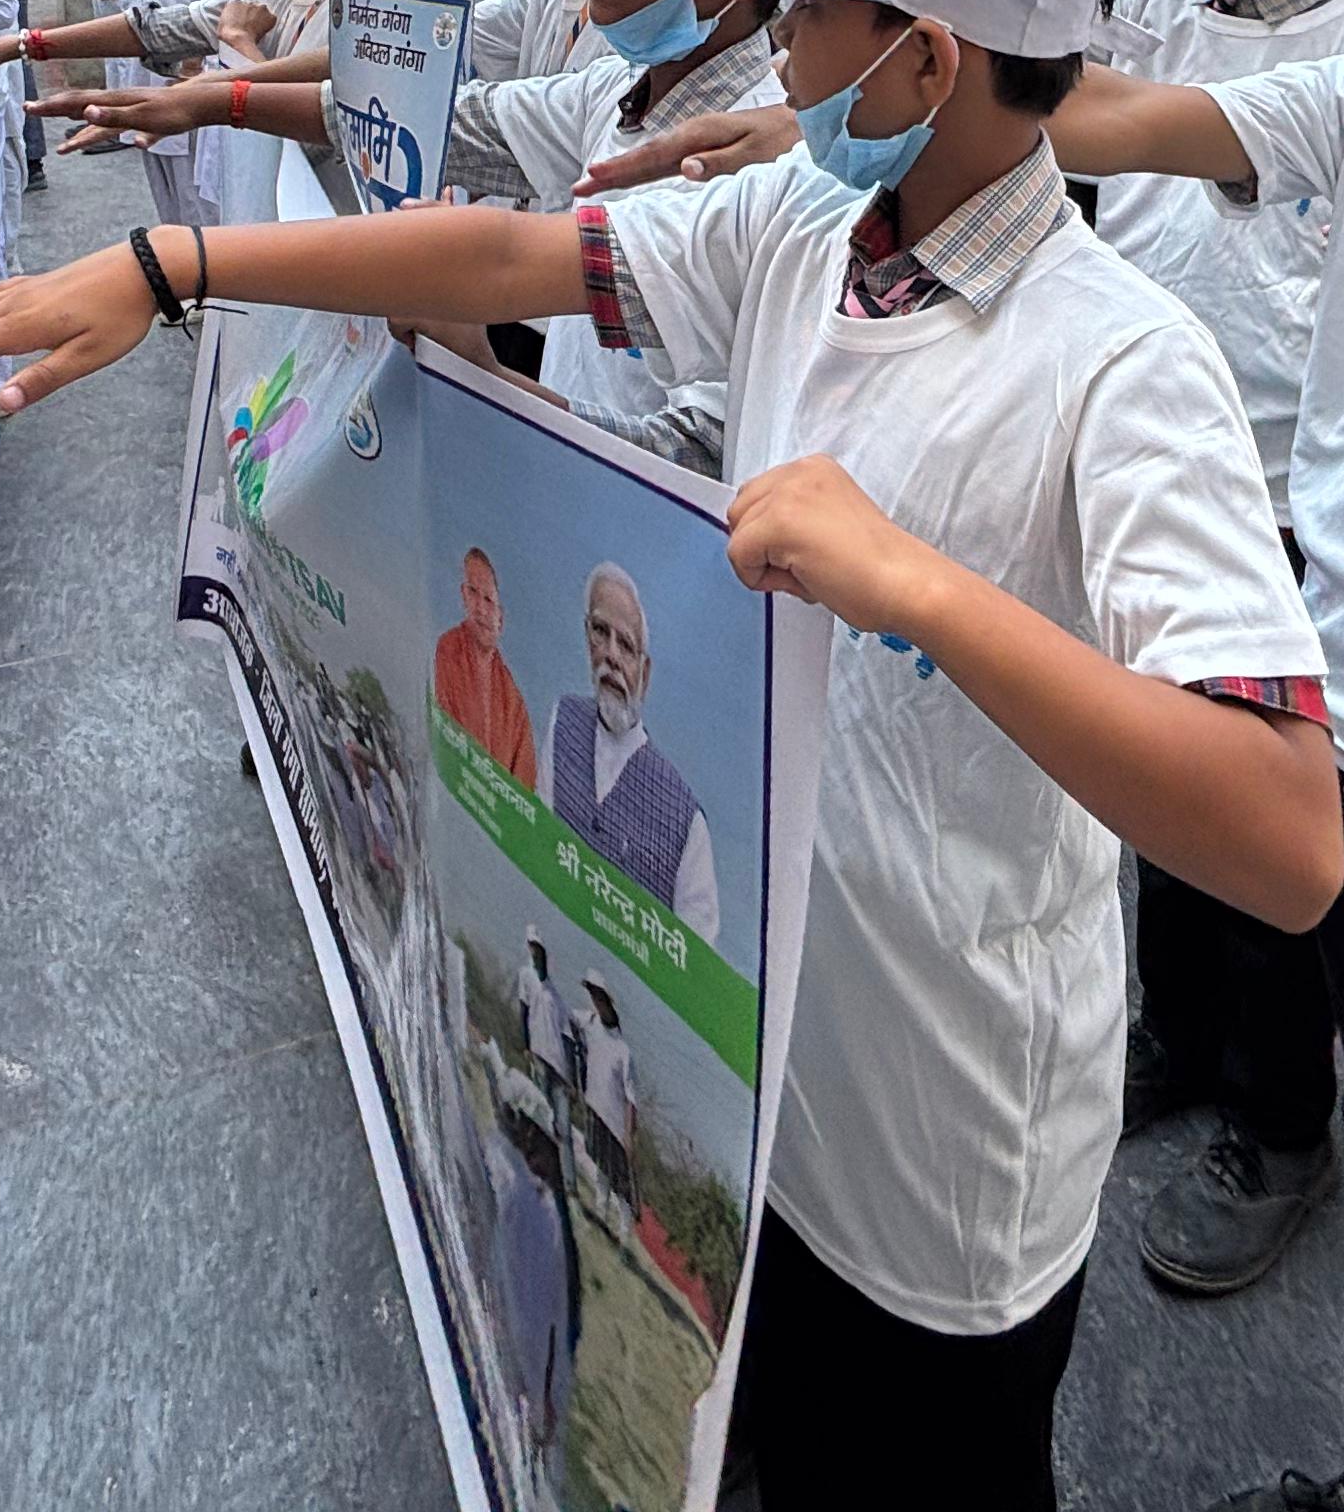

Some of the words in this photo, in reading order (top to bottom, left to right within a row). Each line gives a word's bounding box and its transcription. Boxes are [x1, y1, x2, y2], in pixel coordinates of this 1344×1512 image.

[382, 3, 412, 35] गंगा
[353, 33, 392, 65] अविरल
[394, 40, 427, 73] गंगा
[557, 840, 581, 882] श्री
[582, 862, 637, 929] नरेन्द्र
[638, 906, 689, 972] मोदी
